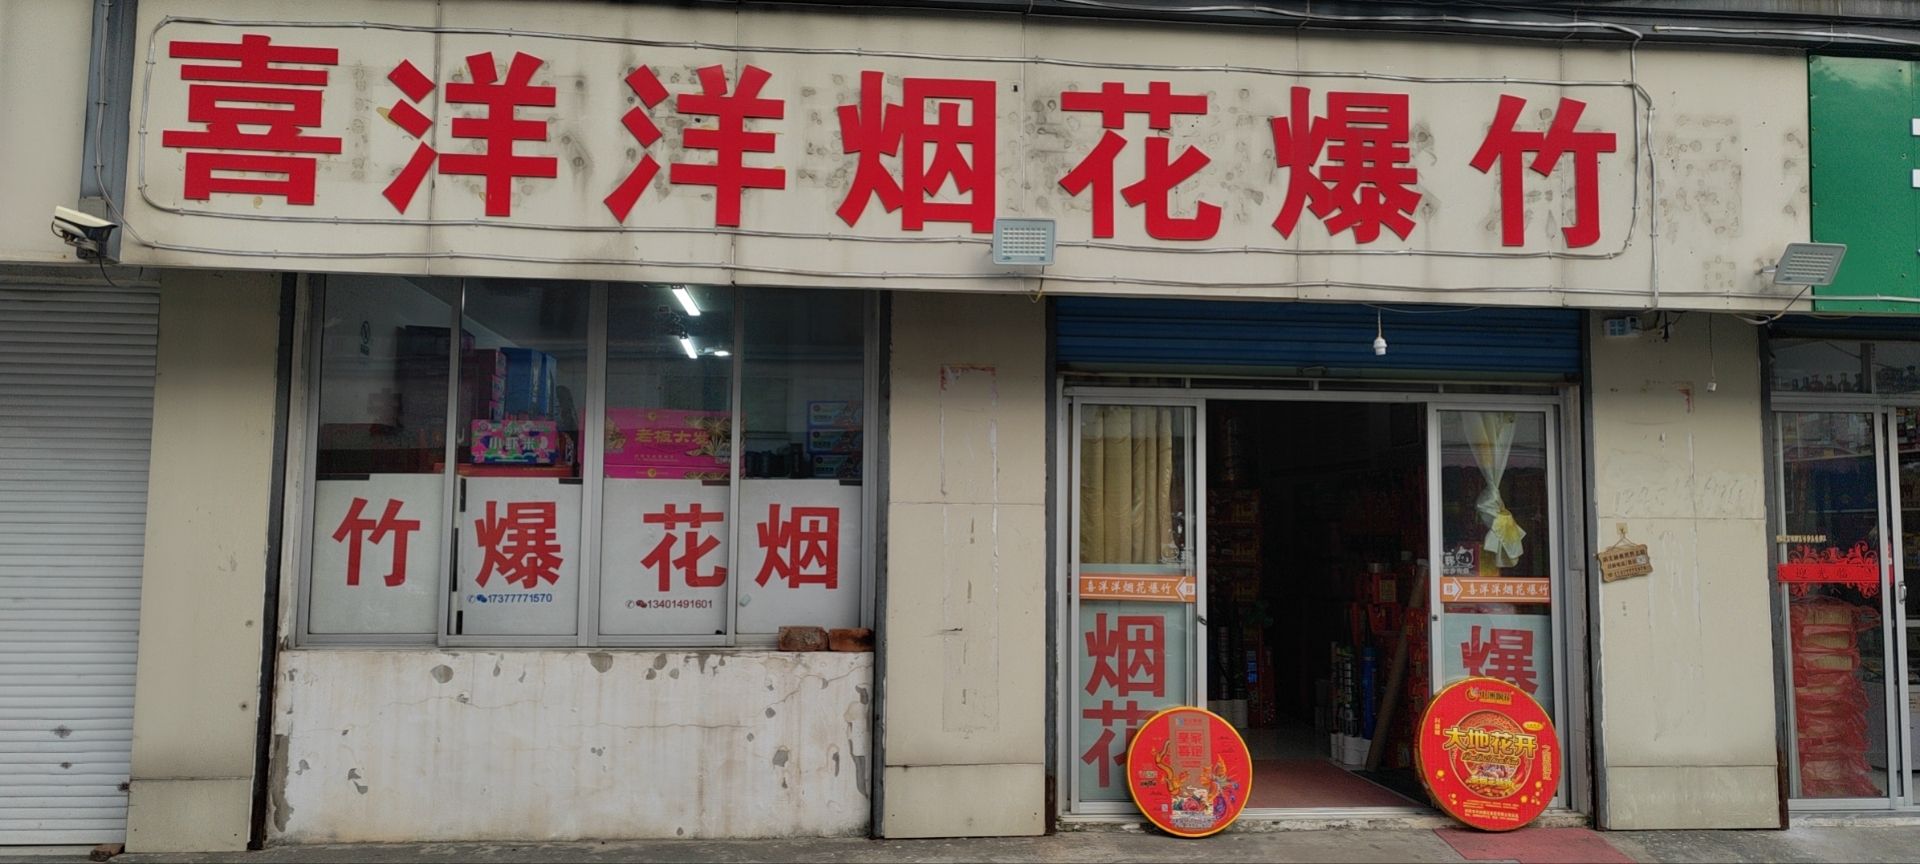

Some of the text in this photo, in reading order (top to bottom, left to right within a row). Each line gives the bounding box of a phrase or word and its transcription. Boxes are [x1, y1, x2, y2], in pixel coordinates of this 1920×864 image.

[163, 35, 1617, 249] 喜洋洋烟花爆竹
[332, 498, 840, 592] 竹 爆 花 烟
[1087, 580, 1171, 594] 喜洋洋烟花爆竹
[1467, 583, 1549, 596] 喜洋洋烟花爆竹
[487, 593, 553, 603] 17377771570
[647, 600, 713, 609] 13401491601
[1443, 726, 1538, 759] 大地花开
